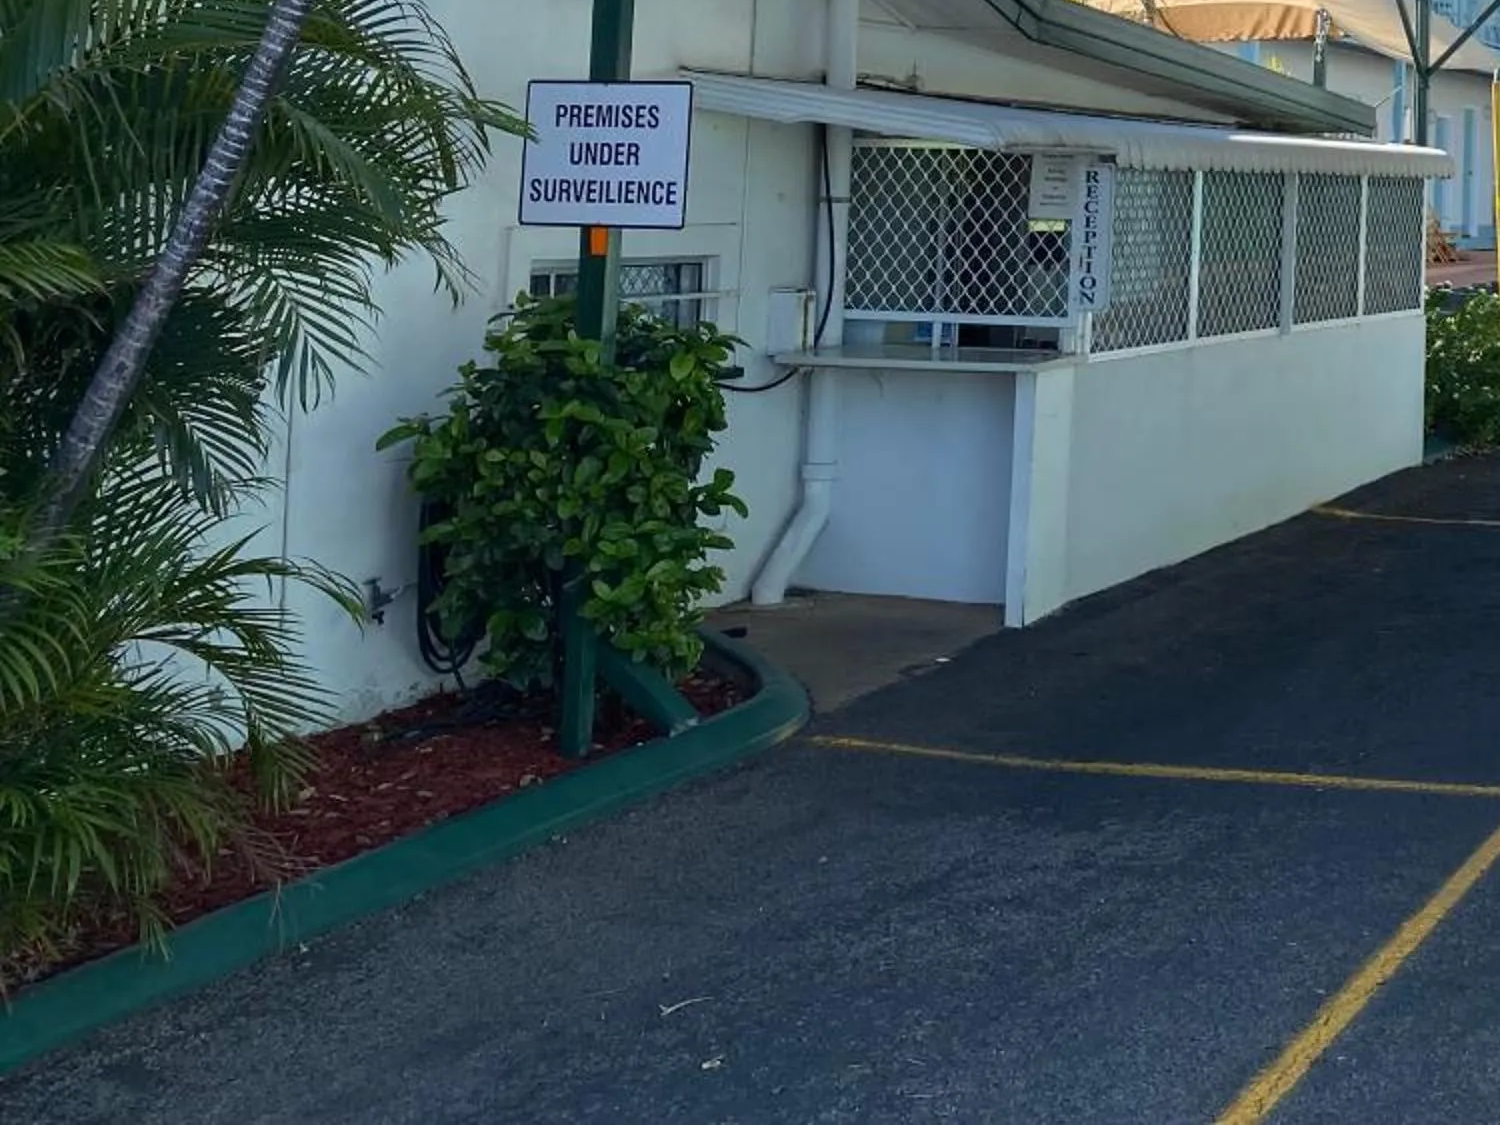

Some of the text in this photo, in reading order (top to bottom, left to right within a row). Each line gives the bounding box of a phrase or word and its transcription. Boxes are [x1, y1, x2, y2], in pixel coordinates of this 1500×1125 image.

[555, 104, 660, 129] PREMISES
[569, 142, 641, 166] UNDER
[529, 178, 678, 205] SURVEILIENCE
[1079, 170, 1100, 306] RECEPTION
